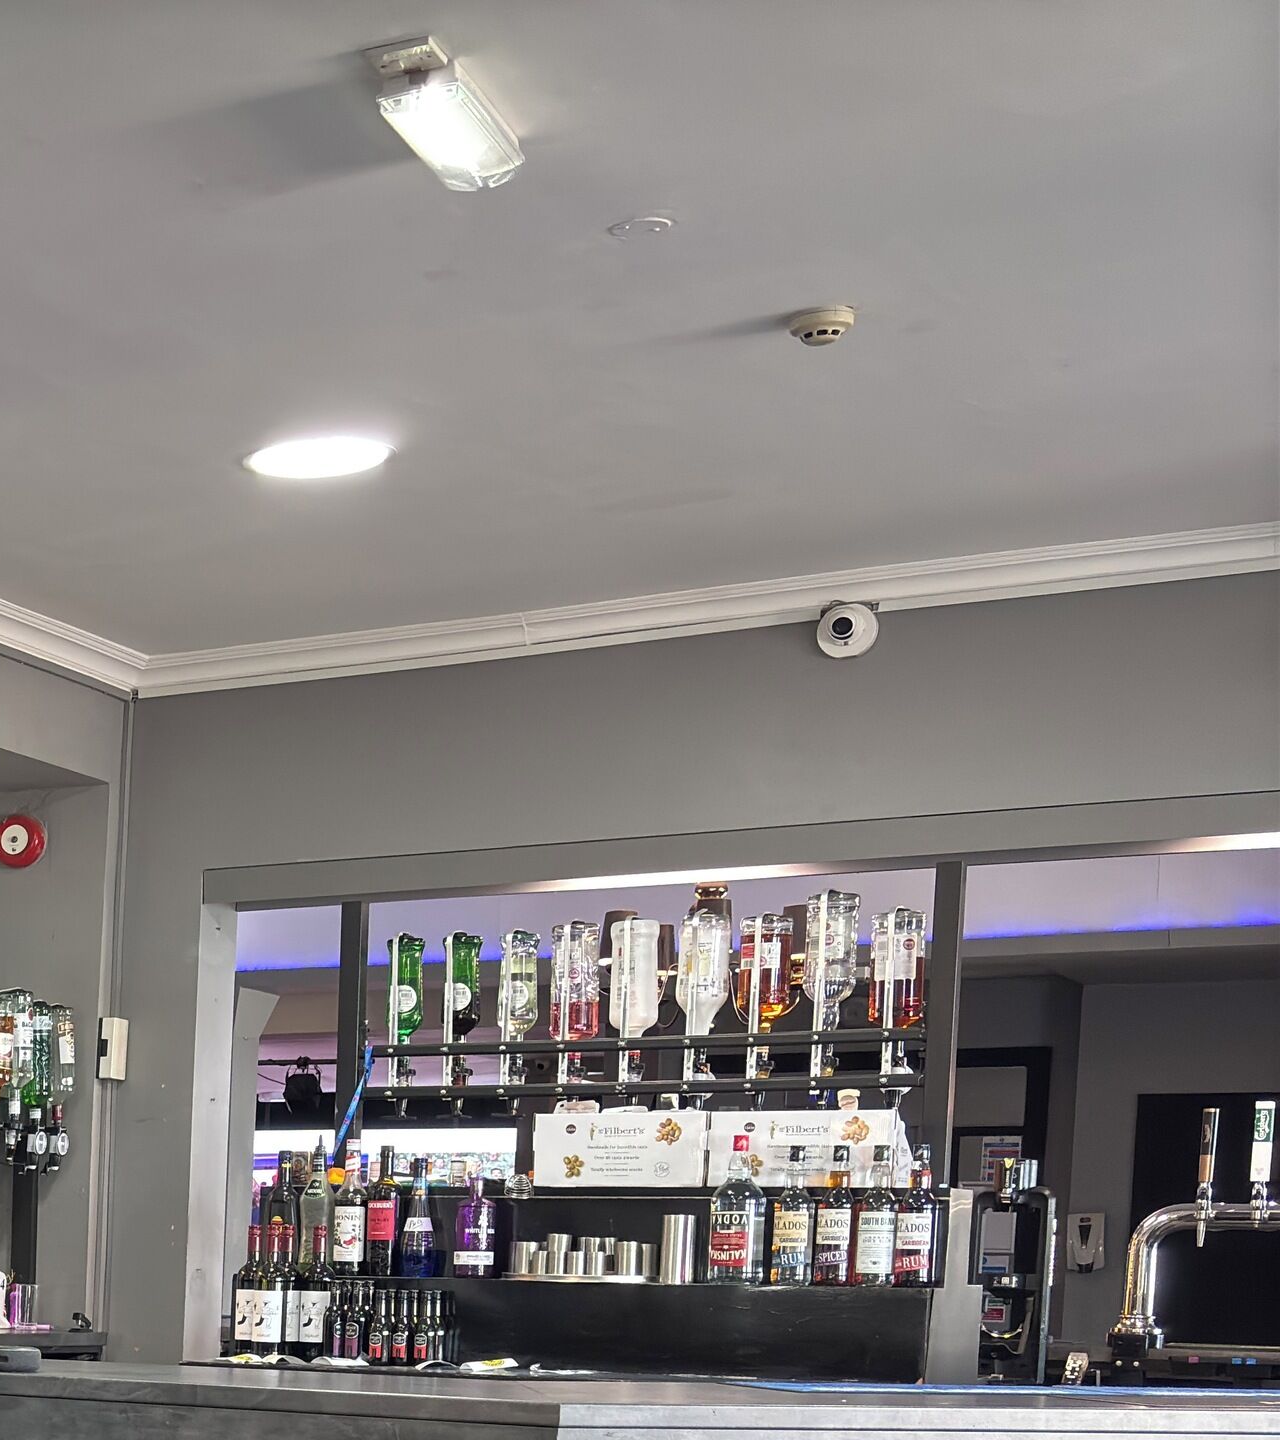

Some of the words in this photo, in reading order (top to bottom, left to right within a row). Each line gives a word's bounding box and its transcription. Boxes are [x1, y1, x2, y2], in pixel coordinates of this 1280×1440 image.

[780, 1252, 805, 1265] RUM
[818, 1250, 847, 1262] SPICED
[902, 1254, 928, 1269] RUM
